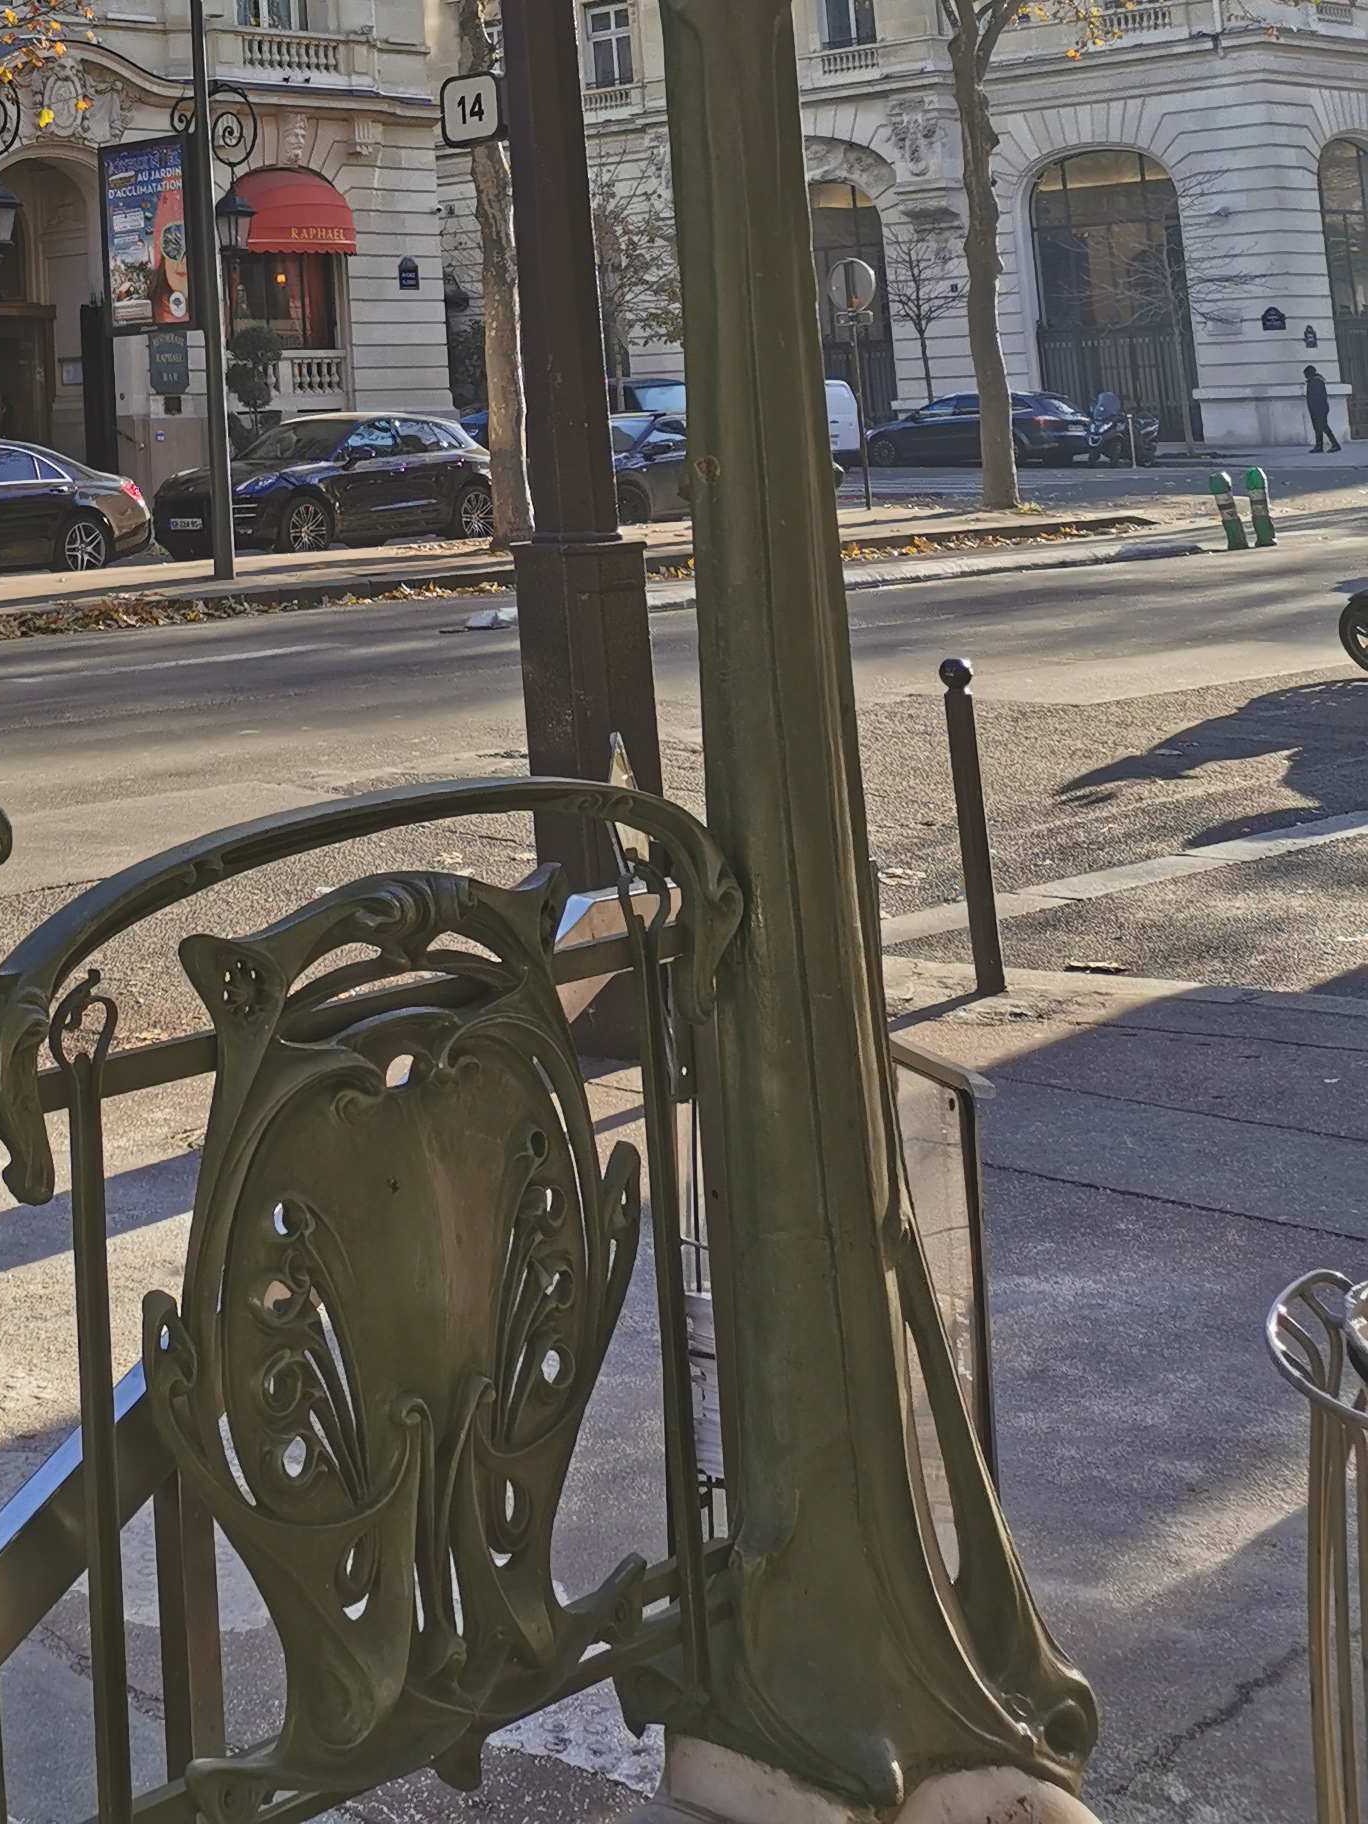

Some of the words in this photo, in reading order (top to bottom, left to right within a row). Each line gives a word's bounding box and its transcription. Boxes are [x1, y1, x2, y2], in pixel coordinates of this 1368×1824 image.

[457, 92, 485, 125] 14
[137, 171, 149, 182] AU
[150, 166, 182, 180] JARDIN
[108, 179, 182, 200] D'ACCLIMATATION
[291, 227, 346, 240] RAPHAEL
